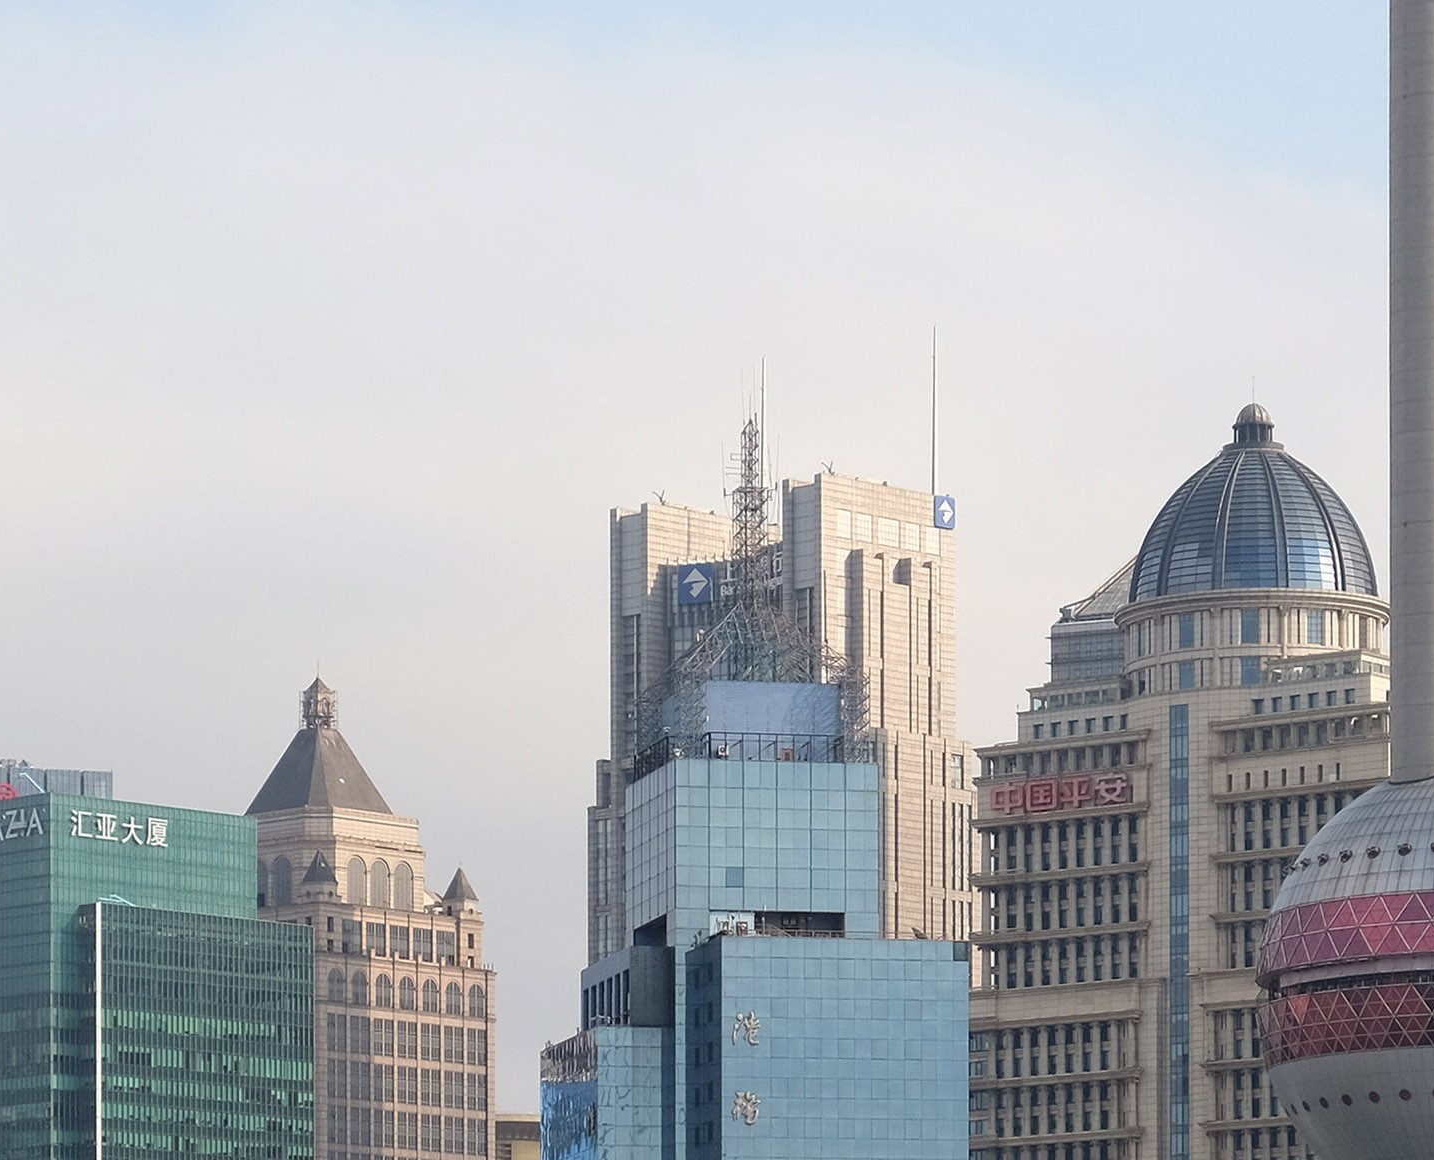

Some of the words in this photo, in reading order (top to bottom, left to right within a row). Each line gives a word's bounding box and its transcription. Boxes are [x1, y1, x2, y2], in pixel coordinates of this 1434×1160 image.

[991, 773, 1127, 814] 中国平安
[70, 809, 169, 847] 汇亚大厦
